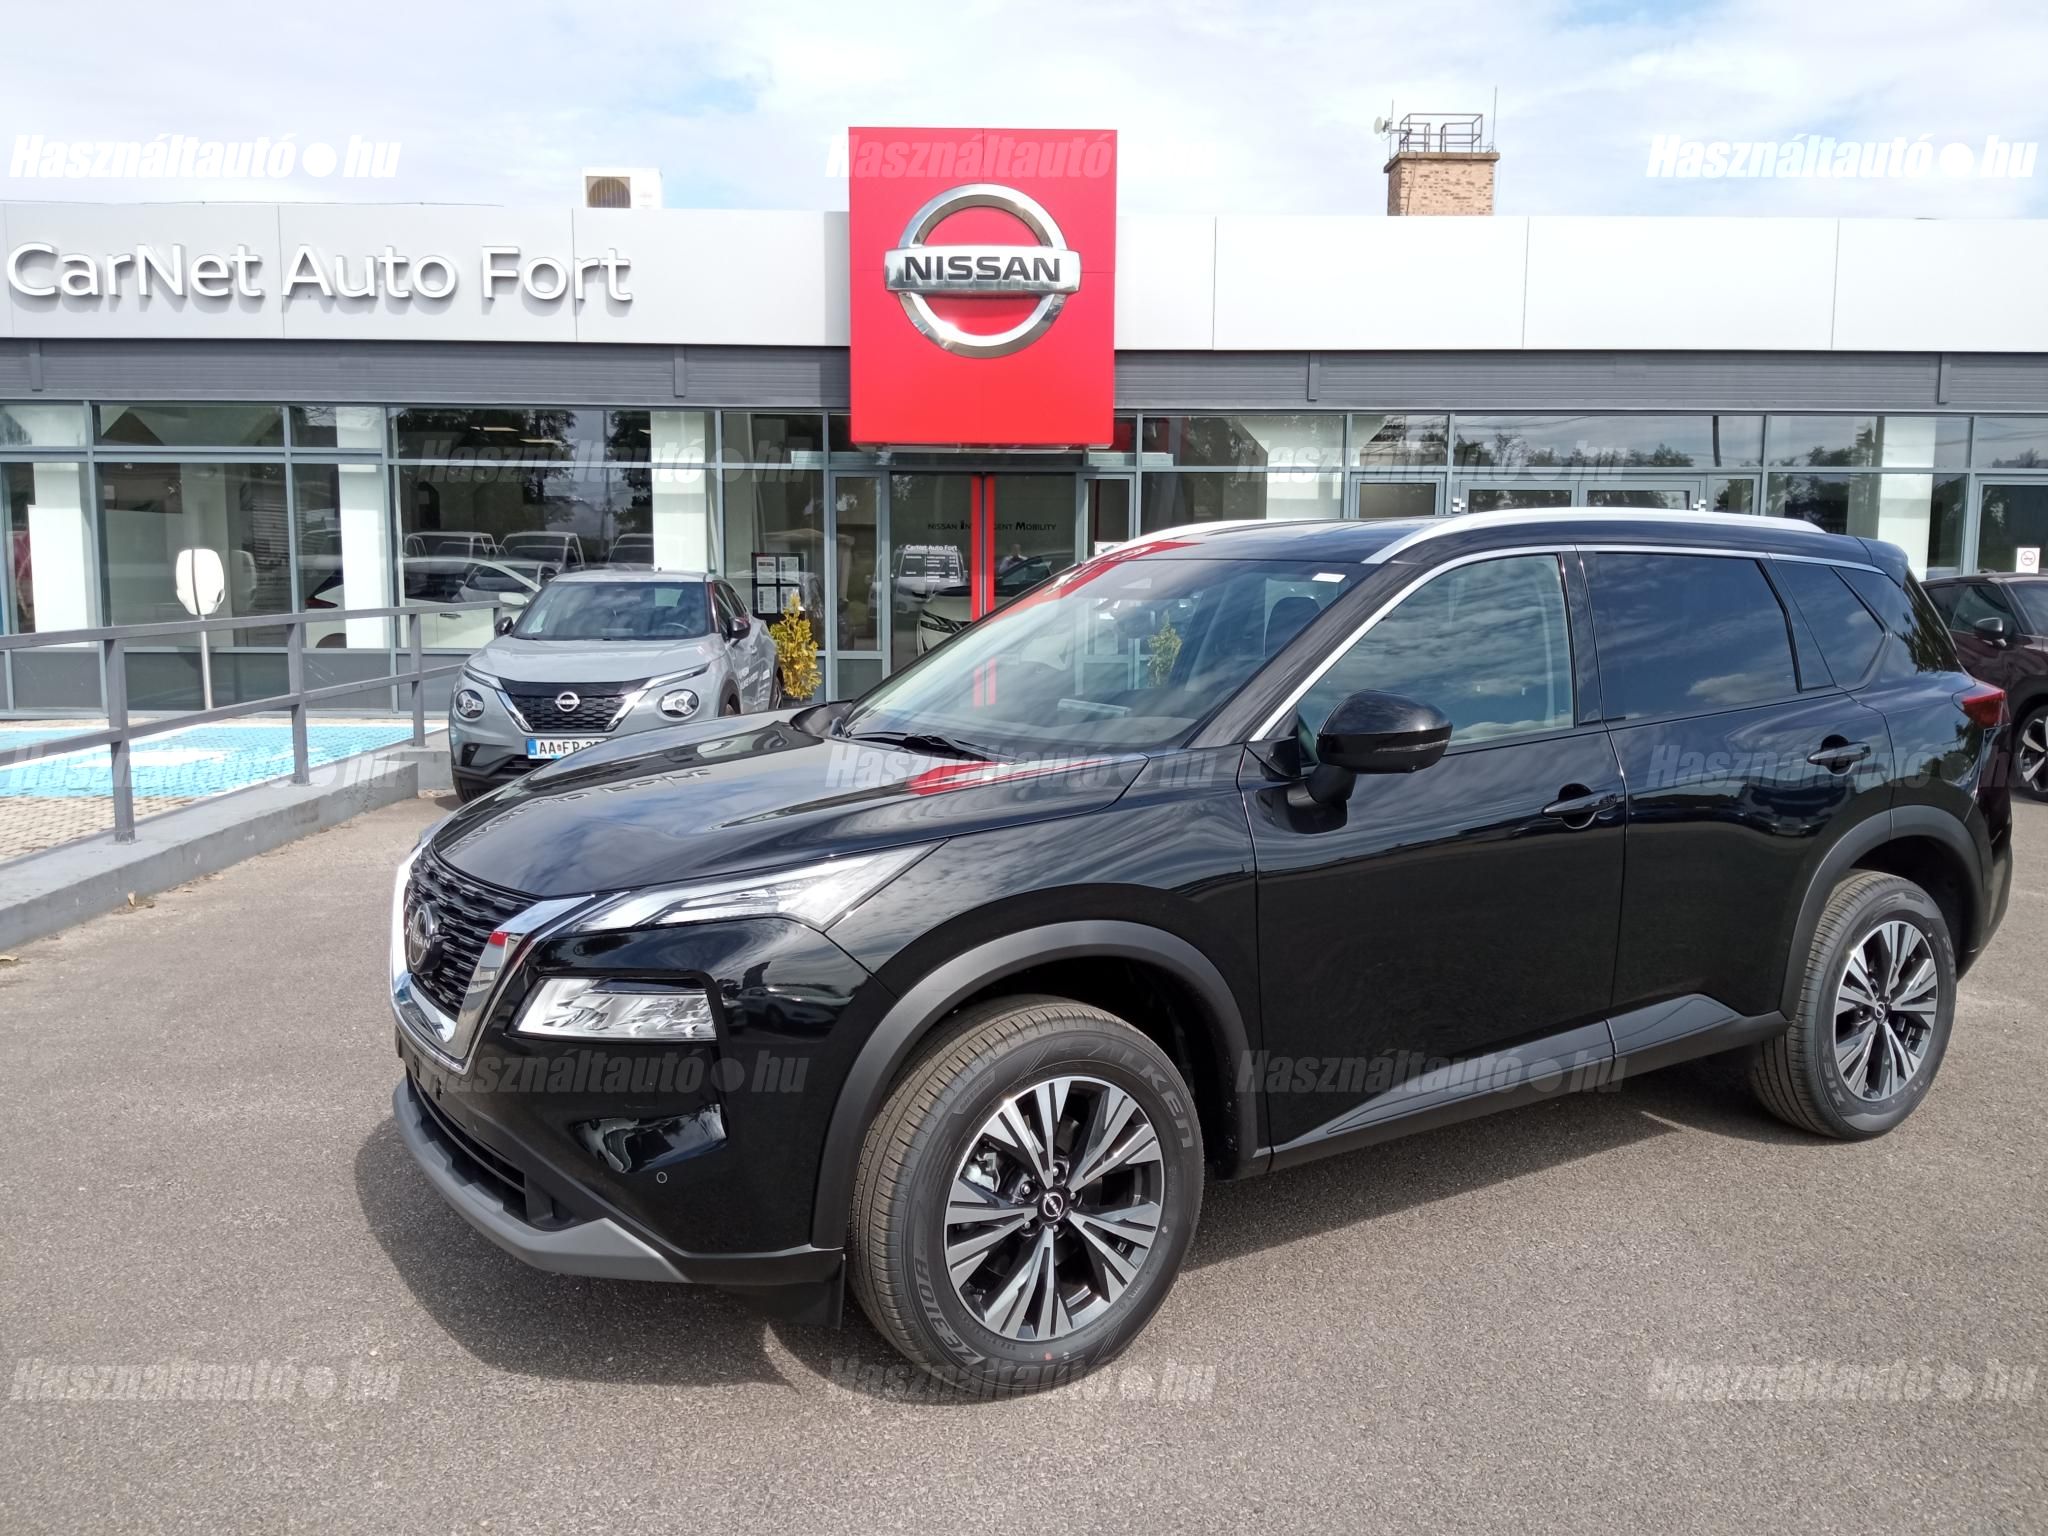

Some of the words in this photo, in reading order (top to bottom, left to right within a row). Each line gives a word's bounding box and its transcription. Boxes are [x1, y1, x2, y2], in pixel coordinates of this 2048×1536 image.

[6, 240, 266, 299] CarNet
[282, 242, 458, 300] Auto
[481, 245, 634, 303] Fort
[903, 255, 1061, 282] NISSAN
[539, 741, 556, 755] AA
